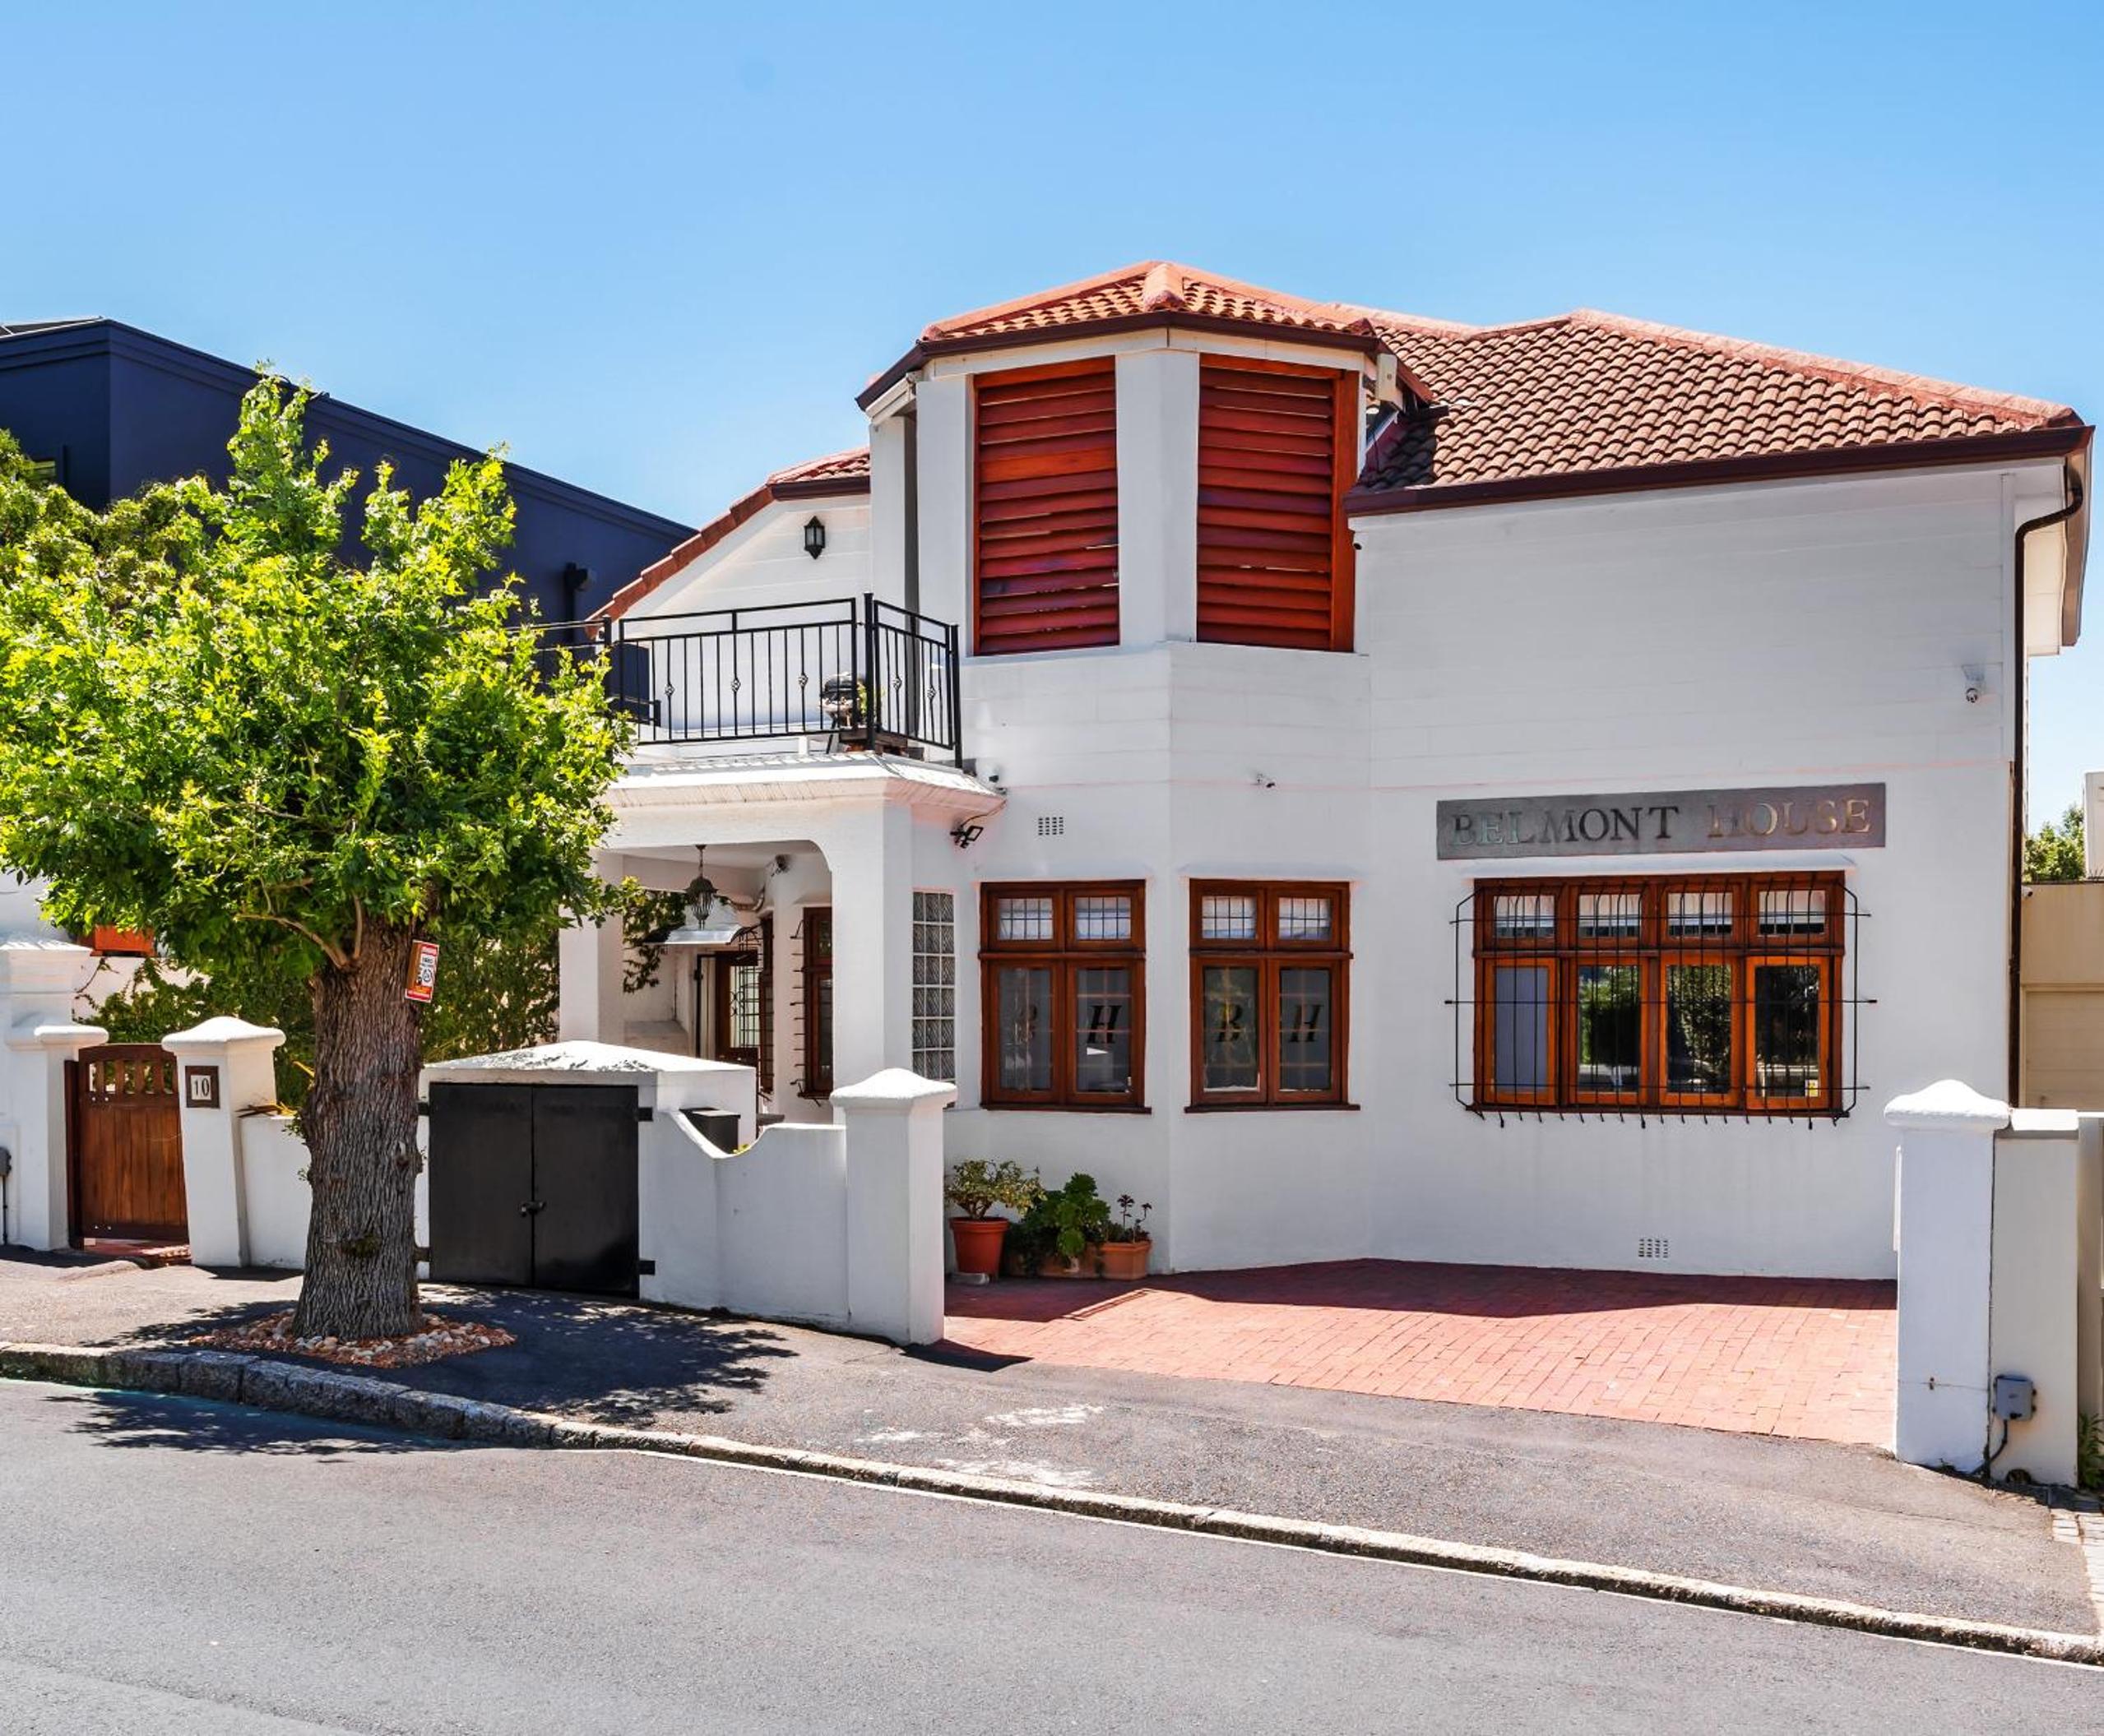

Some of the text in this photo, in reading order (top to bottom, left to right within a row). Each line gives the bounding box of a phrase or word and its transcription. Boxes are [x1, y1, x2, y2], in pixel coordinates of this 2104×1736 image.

[1451, 799, 1871, 846] BELMONT HOUSE
[195, 1077, 211, 1097] 10
